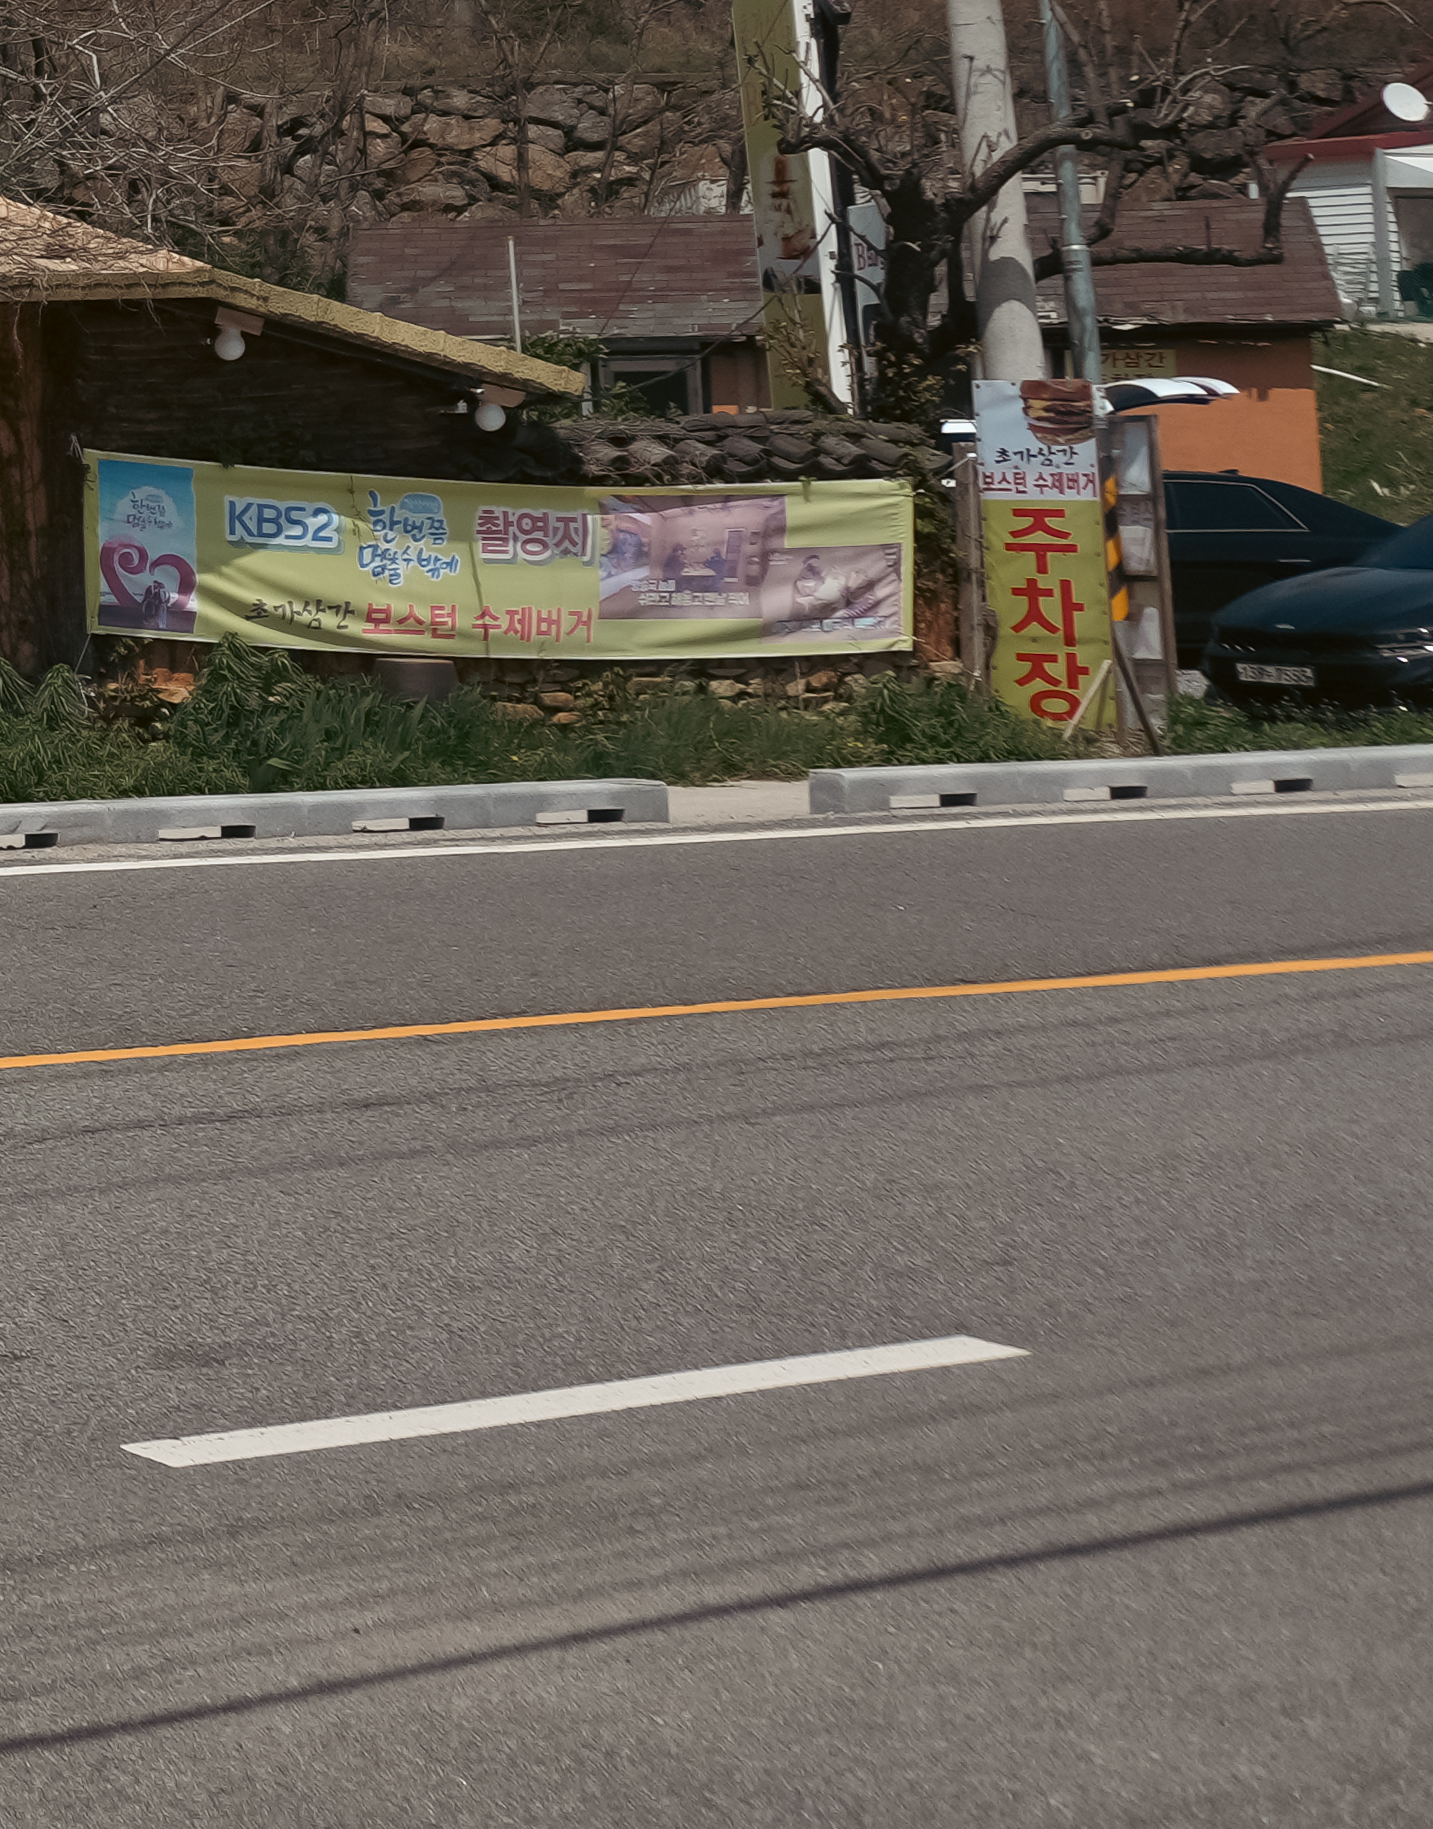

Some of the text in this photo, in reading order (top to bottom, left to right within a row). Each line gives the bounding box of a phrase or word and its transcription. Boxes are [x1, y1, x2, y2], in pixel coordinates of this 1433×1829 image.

[1101, 351, 1166, 368] 가삼간
[994, 446, 1079, 466] 초가삼간
[982, 471, 1097, 498] 보스턴 수제버거
[228, 500, 333, 542] KBS2
[476, 510, 589, 557] 촬영지
[244, 599, 594, 644] 초가삼간 보스턴 수제버거
[1004, 508, 1090, 721] 주차장
